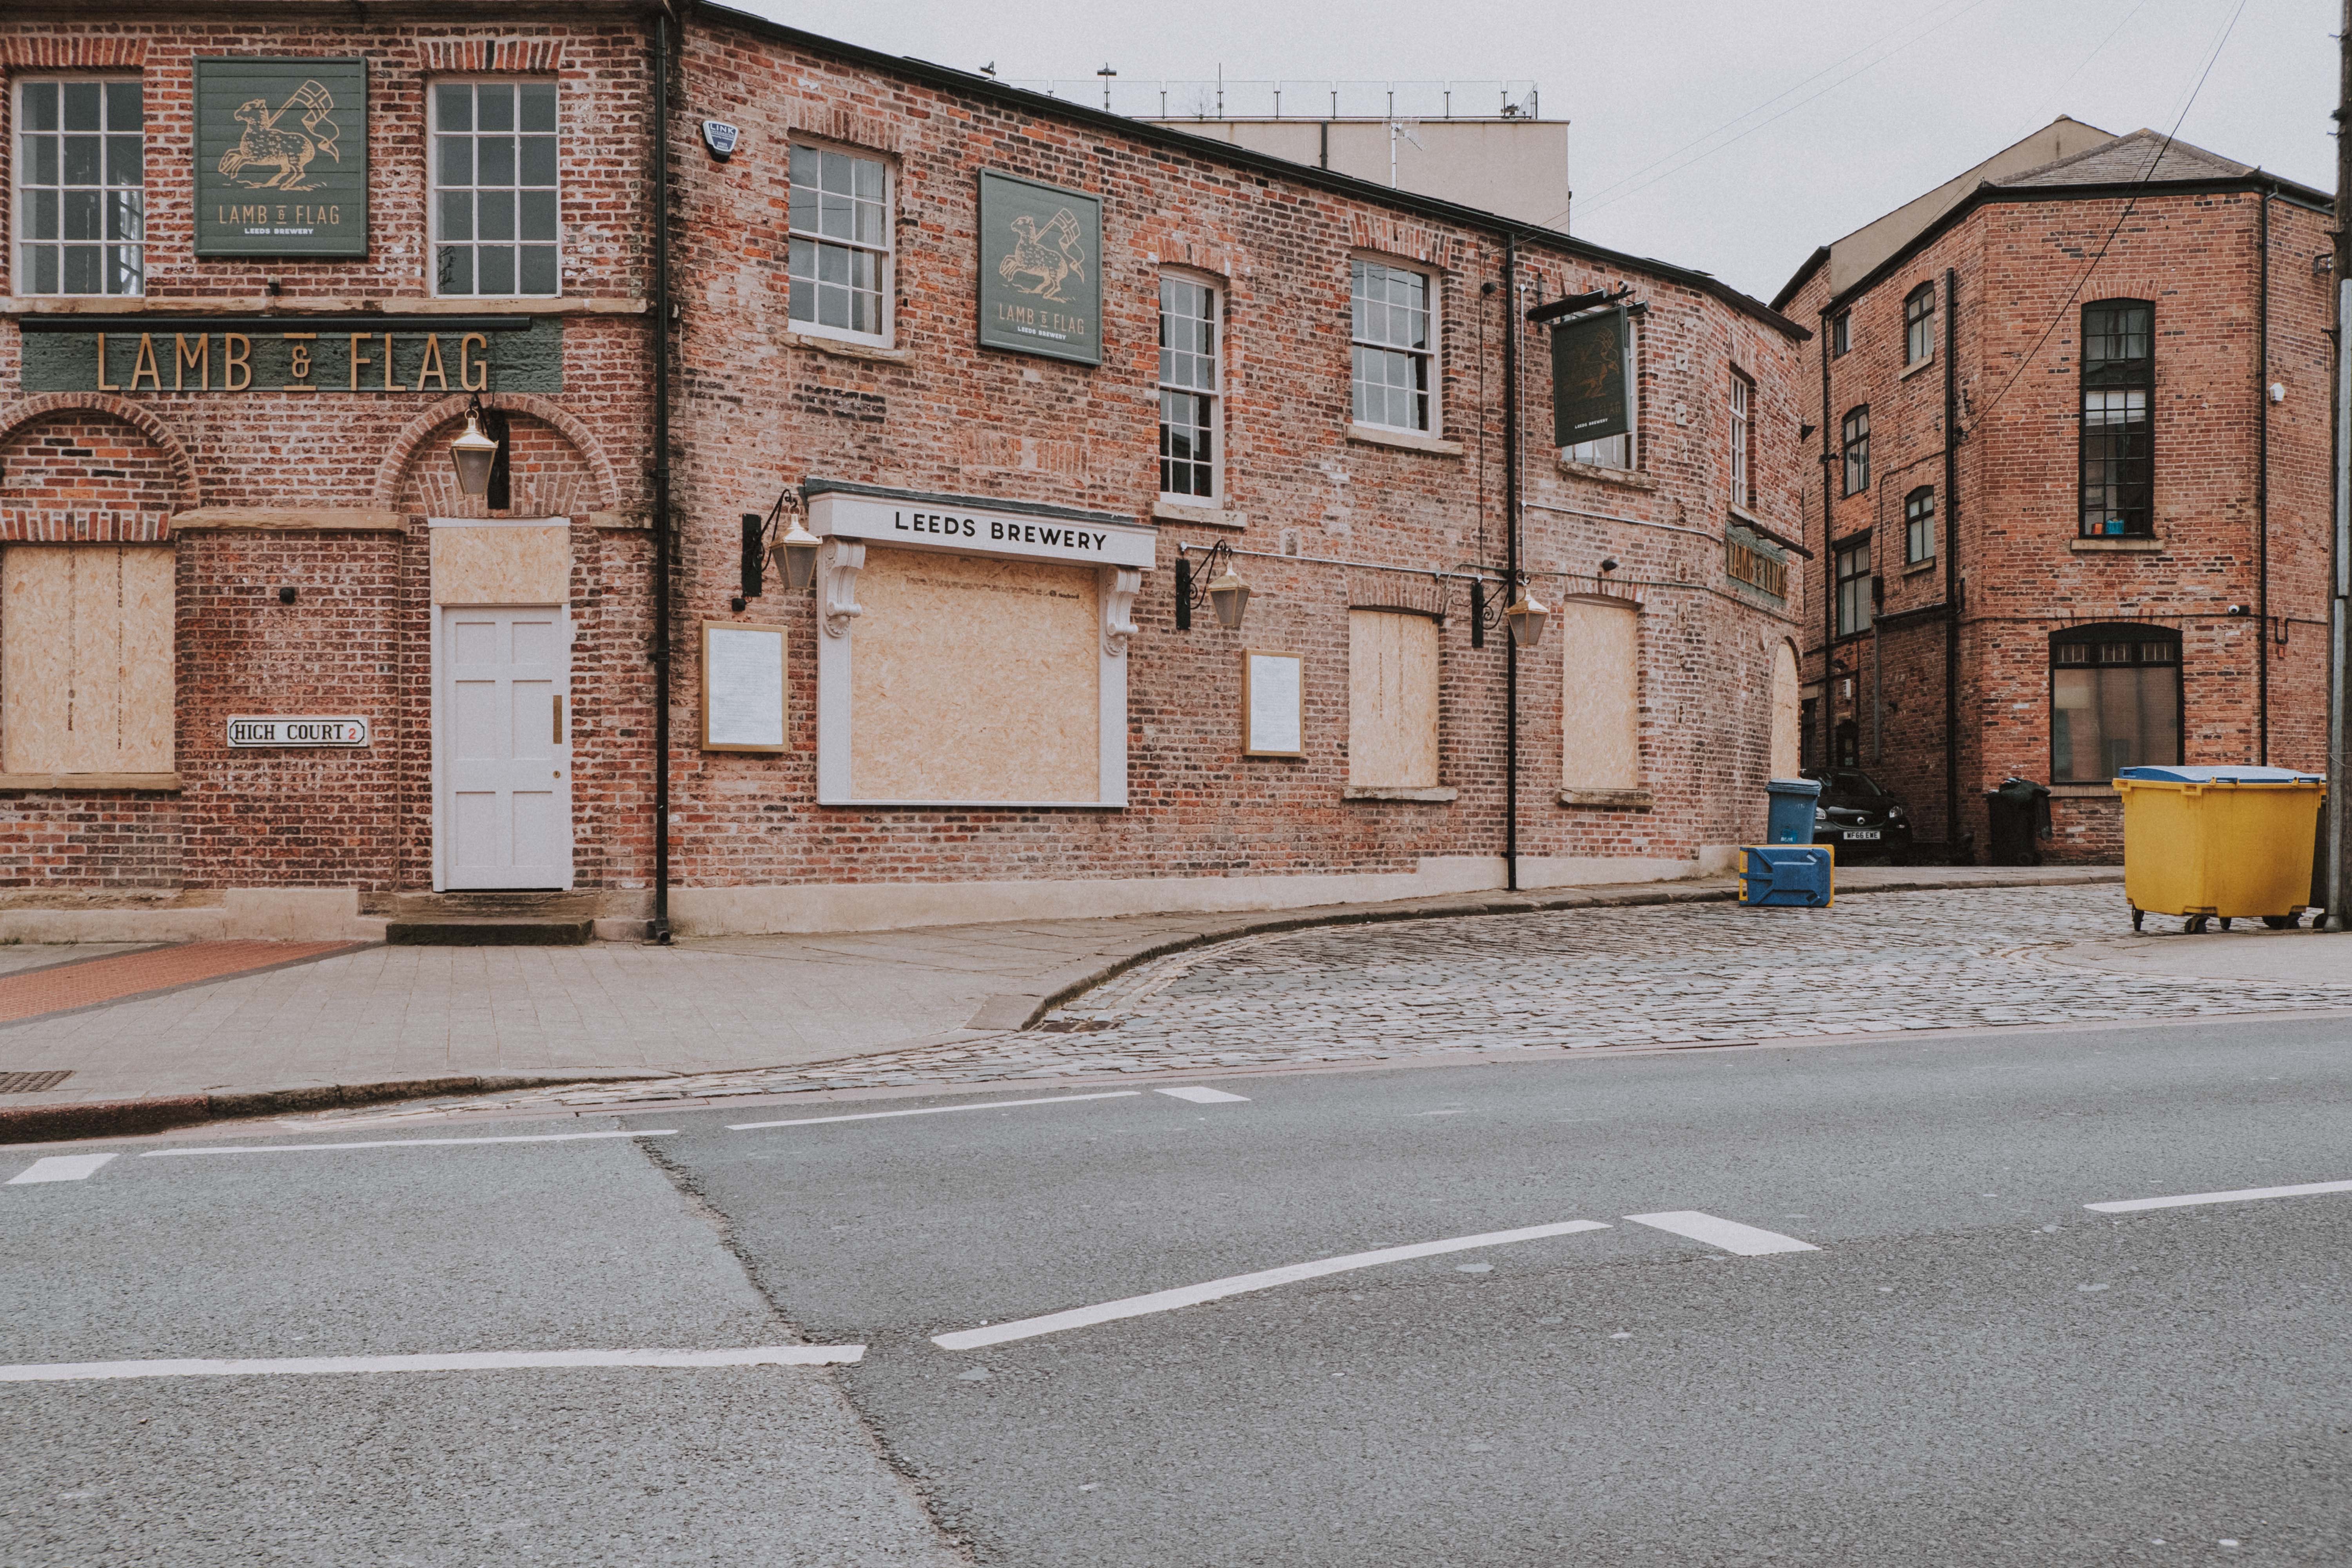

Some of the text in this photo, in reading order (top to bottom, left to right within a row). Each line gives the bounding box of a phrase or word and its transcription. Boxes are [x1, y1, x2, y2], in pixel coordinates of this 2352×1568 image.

[710, 123, 734, 134] LINK
[220, 205, 267, 224] LAMB
[296, 205, 339, 224] FLAG
[999, 303, 1034, 325] LAMB
[1054, 313, 1084, 335] FLAG
[1017, 326, 1067, 340] LEEDS BREWERY
[98, 332, 252, 392] LAMB
[350, 332, 488, 392] FLAG
[1588, 417, 1608, 426] BREWERY
[895, 511, 1107, 551] LEEDS BREWERY
[234, 724, 356, 740] HIGH COURT 2
